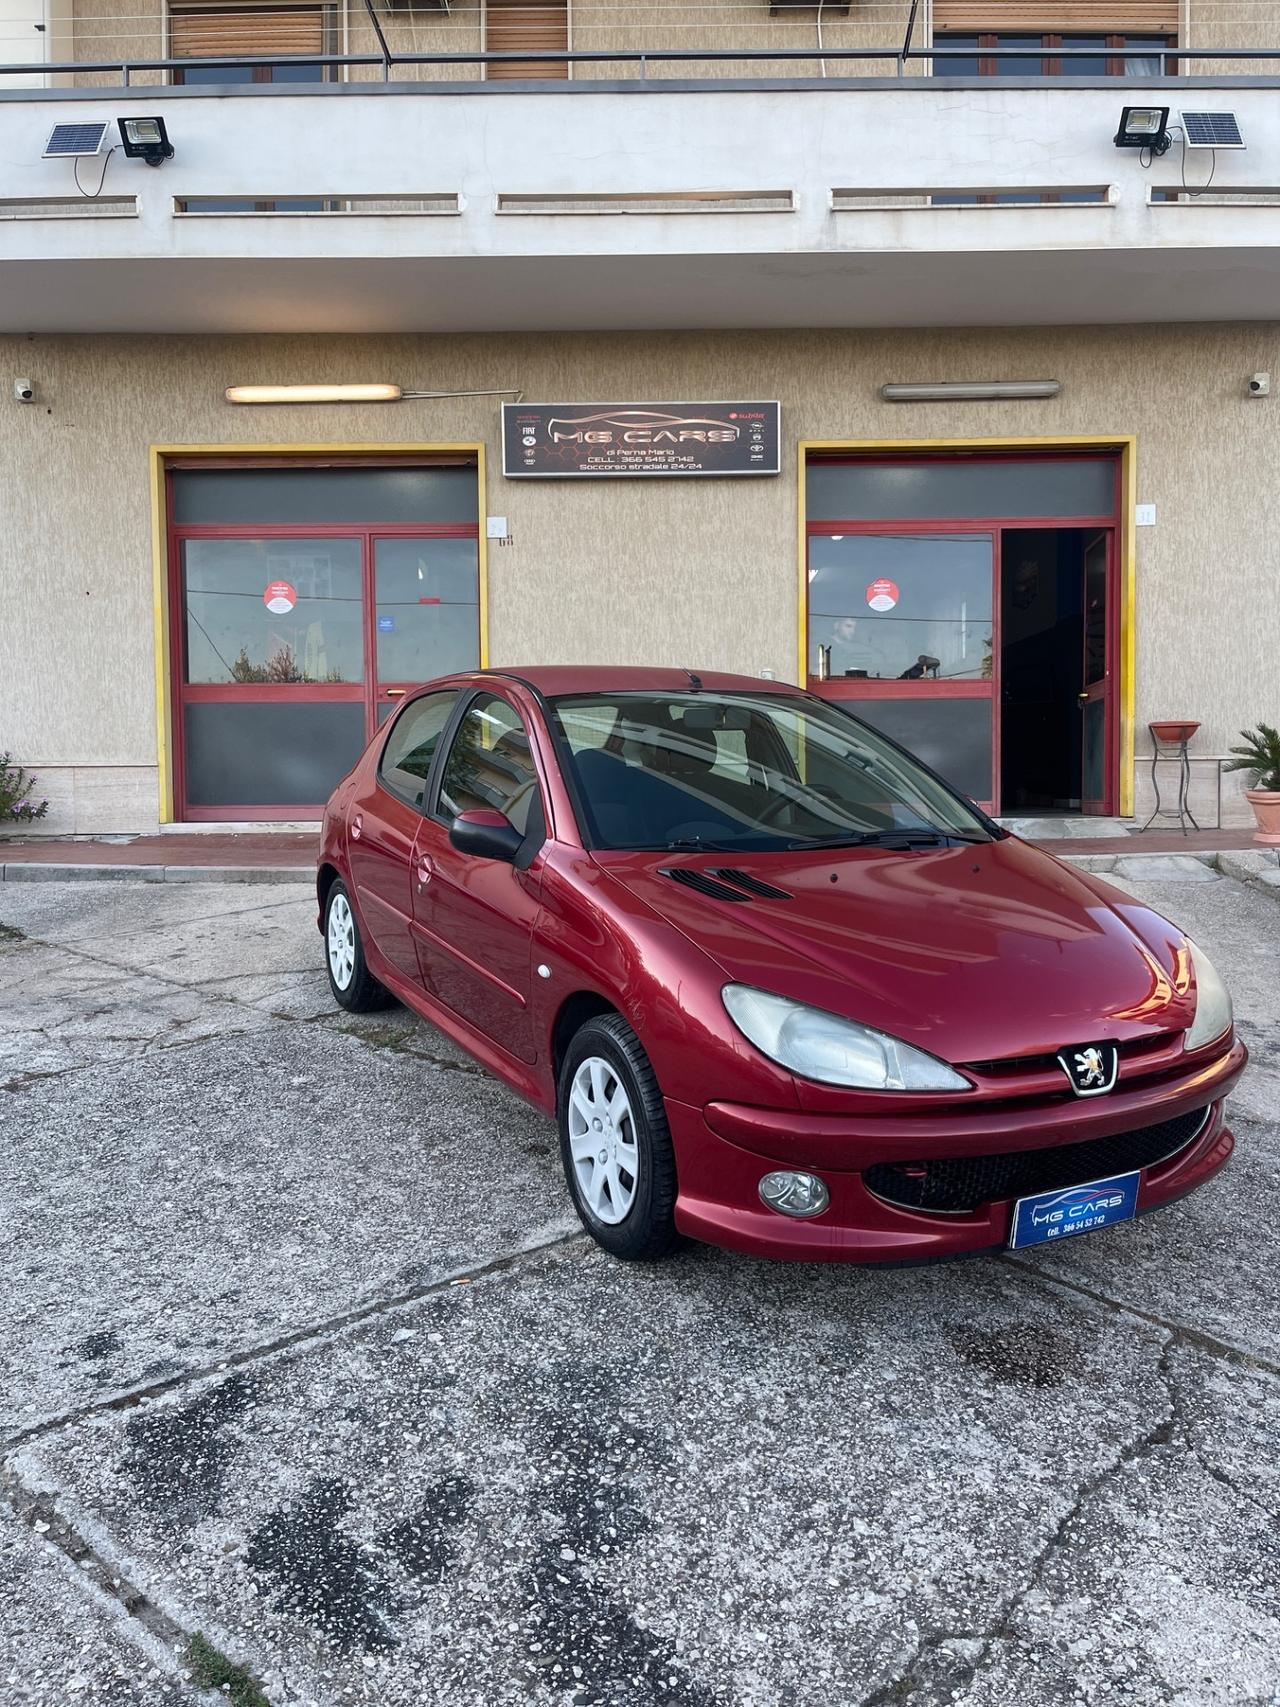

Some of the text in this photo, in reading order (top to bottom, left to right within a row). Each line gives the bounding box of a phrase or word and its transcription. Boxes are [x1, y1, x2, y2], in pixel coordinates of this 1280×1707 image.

[553, 430, 736, 443] MG CARS
[1033, 1195, 1123, 1227] MG CARS
[1063, 1223, 1076, 1233] 366
[1075, 1220, 1084, 1231] 54
[1084, 1217, 1093, 1228] 52
[1093, 1214, 1105, 1226] 742
